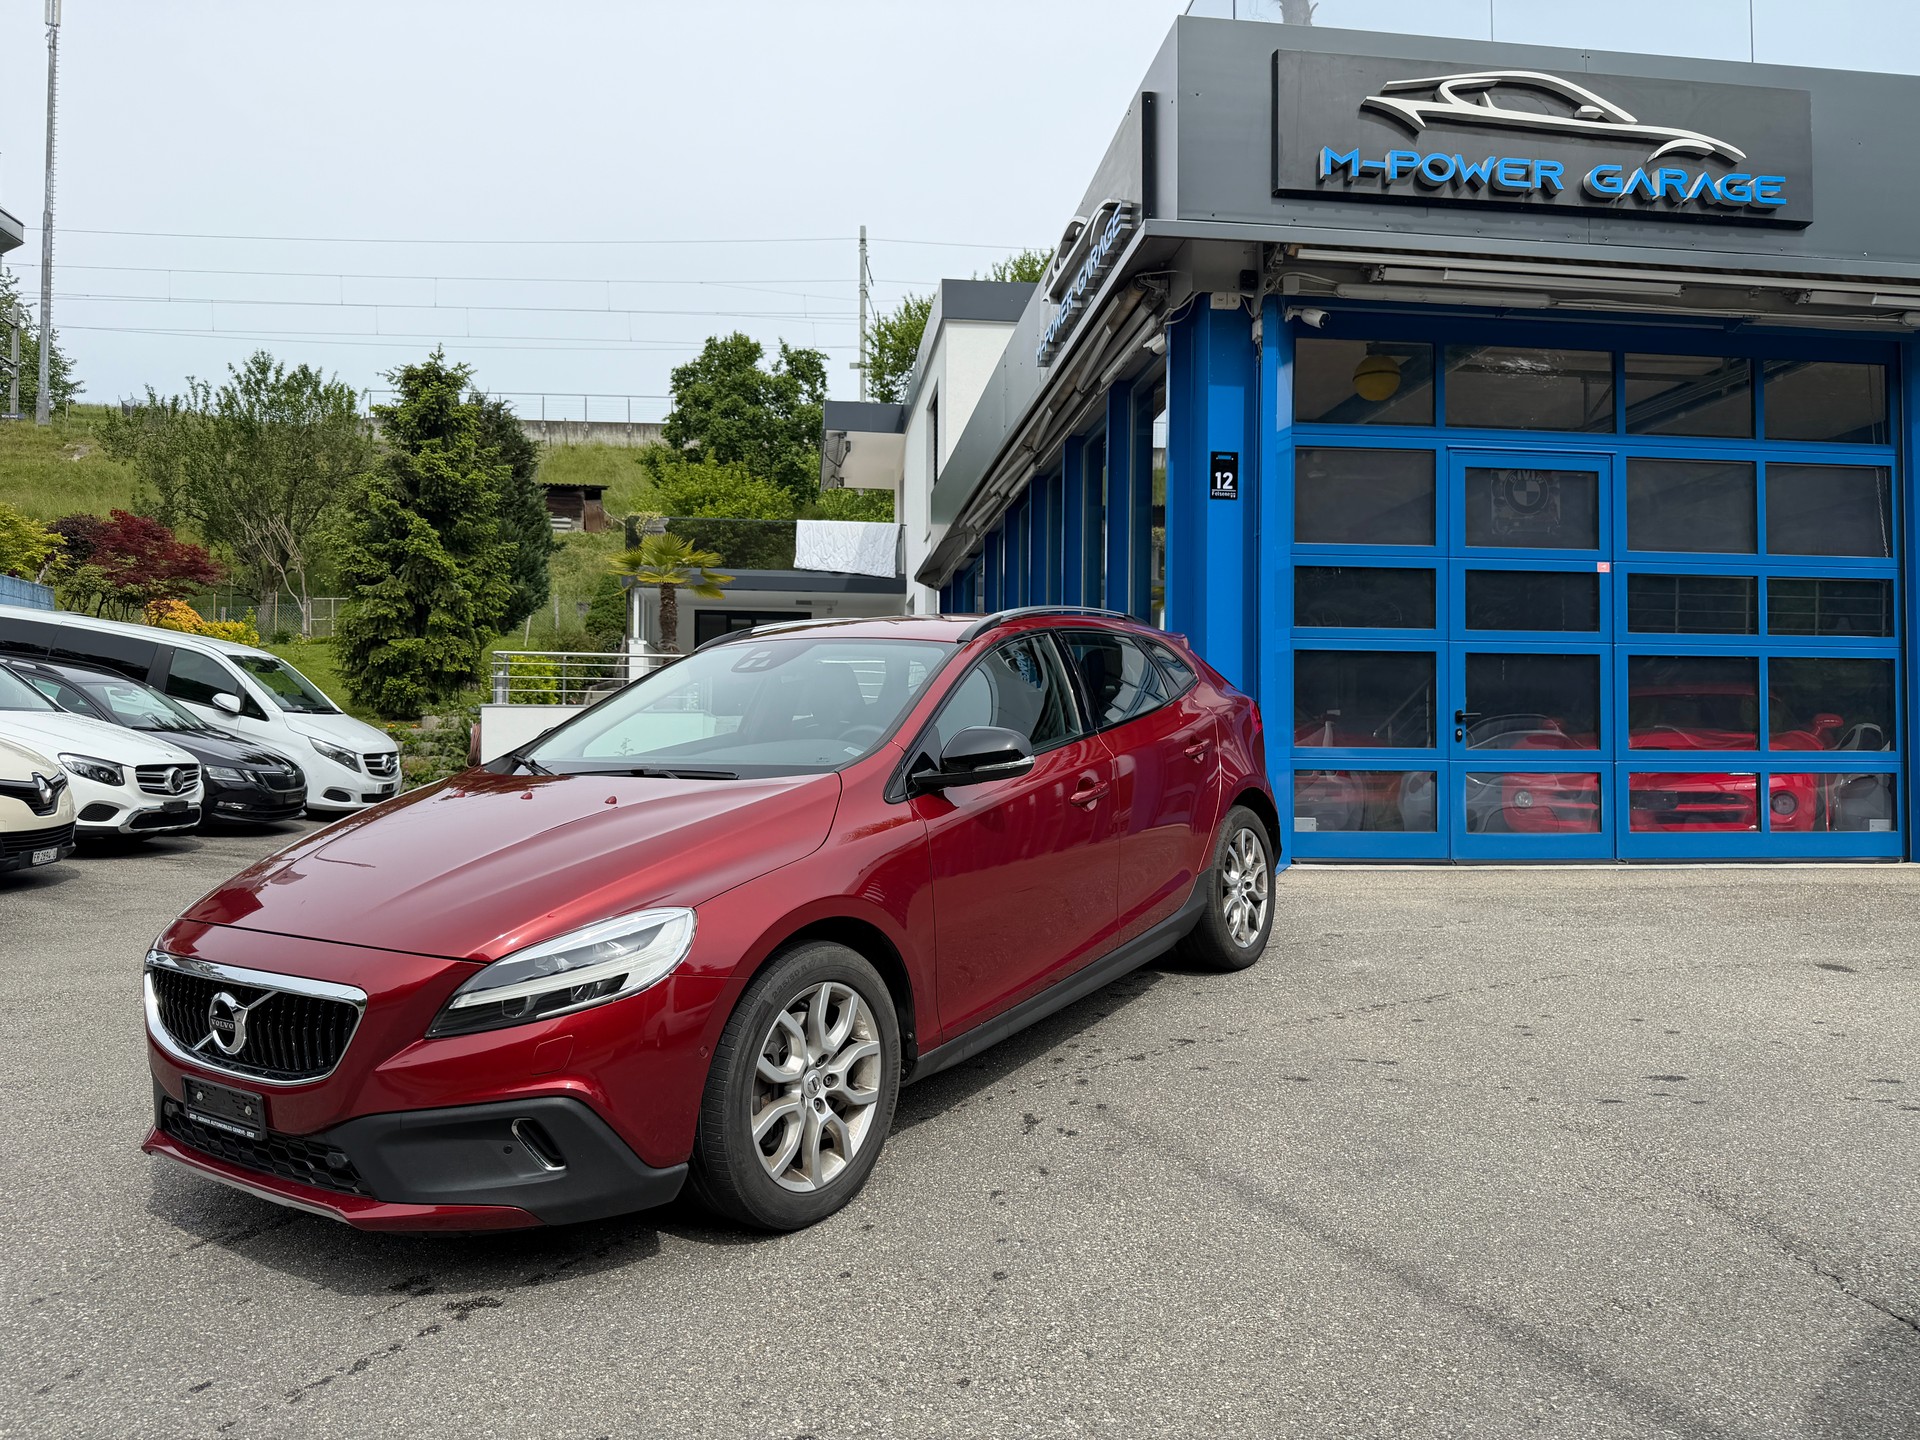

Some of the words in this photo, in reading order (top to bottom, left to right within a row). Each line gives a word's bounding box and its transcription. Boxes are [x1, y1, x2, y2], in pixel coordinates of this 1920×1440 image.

[1320, 145, 1565, 191] M-POWER
[1588, 163, 1787, 205] GARAGE
[1036, 287, 1074, 367] M-POWER
[1076, 203, 1122, 296] GARAGE
[1215, 471, 1234, 490] 12
[211, 1018, 234, 1030] VOLVO
